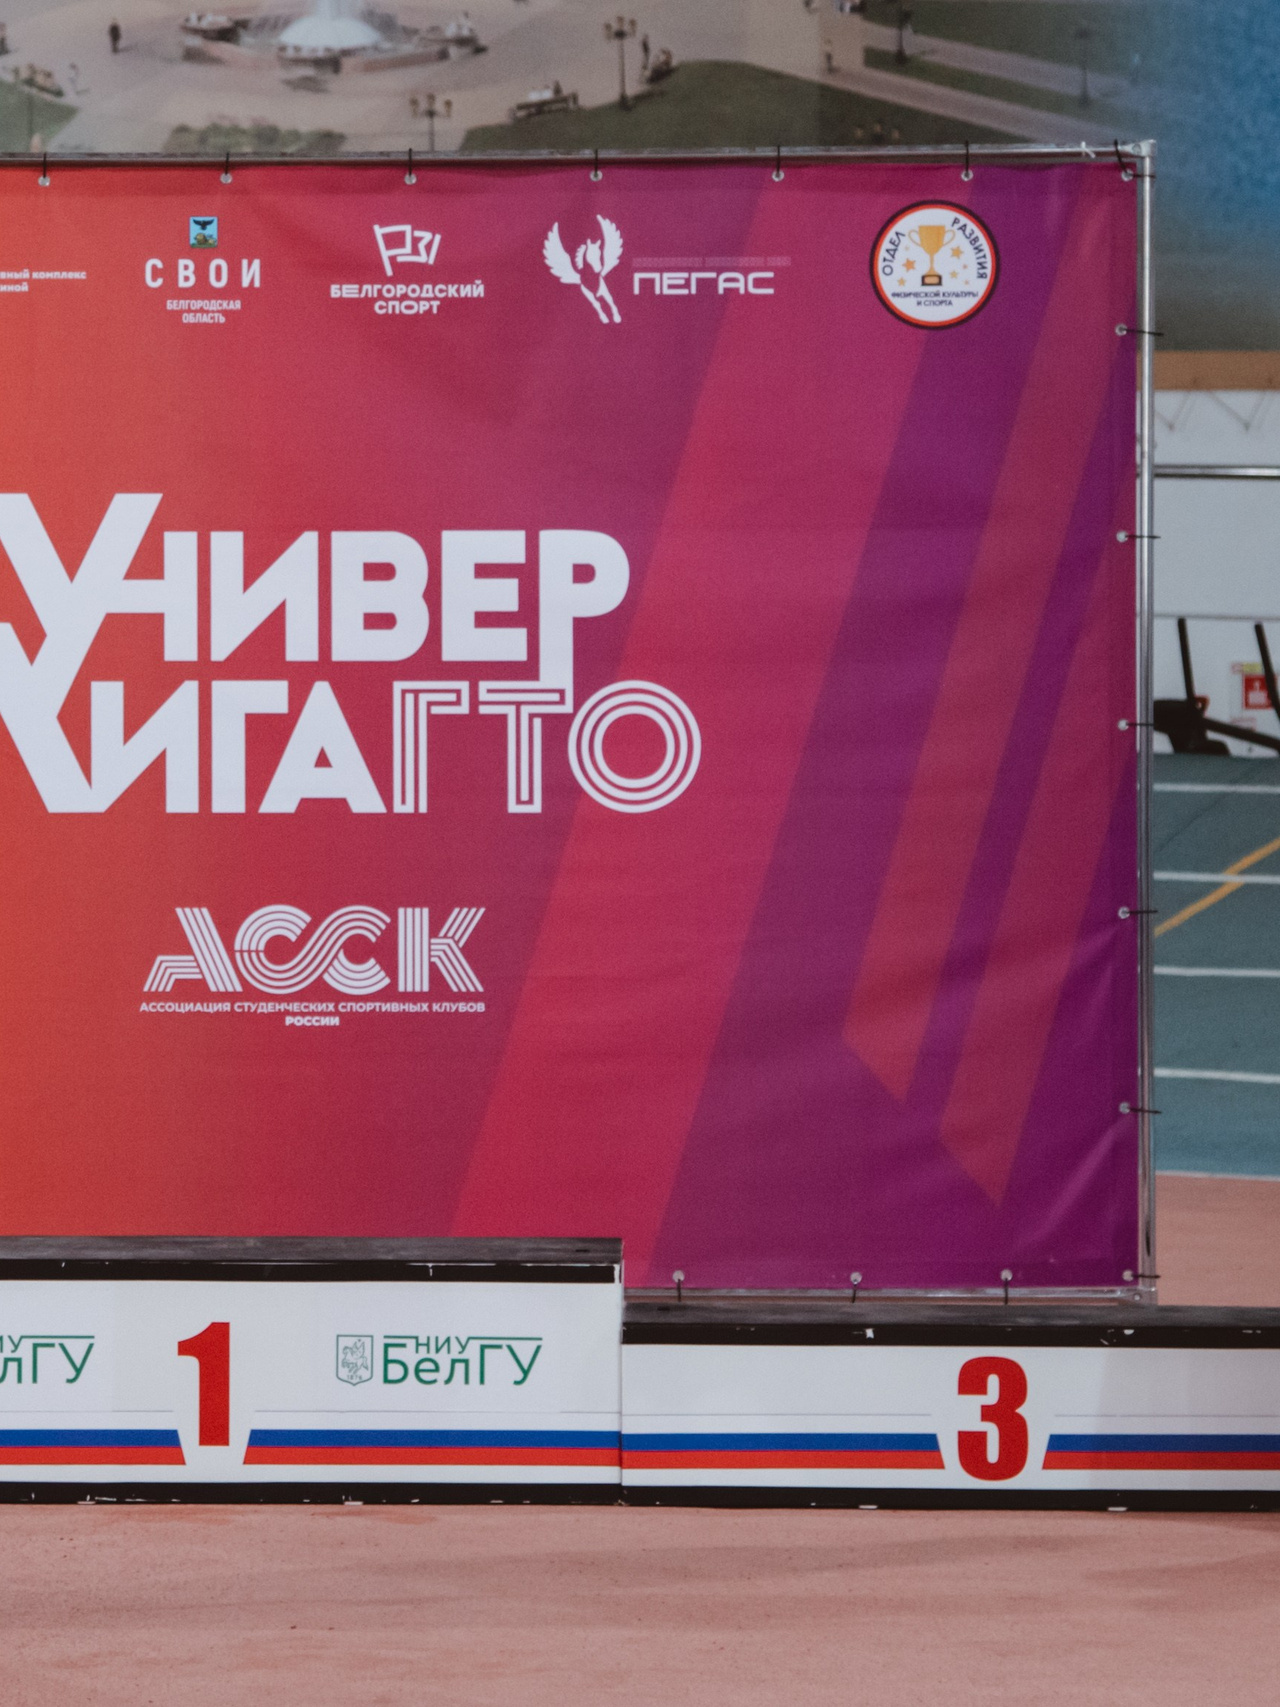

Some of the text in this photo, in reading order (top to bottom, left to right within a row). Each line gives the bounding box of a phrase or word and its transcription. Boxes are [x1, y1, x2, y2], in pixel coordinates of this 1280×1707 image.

[882, 231, 906, 276] ОТДЕЛ
[951, 216, 988, 279] РАЗВИТИЯ
[32, 271, 87, 279] комплекс
[633, 271, 775, 295] ПЕГАС
[330, 279, 485, 298] БЕЛГОРОДСКИЙ
[891, 290, 941, 298] ФИЗИЧЕСКОЙ
[166, 299, 241, 311] БЕЛГОРОДСКАЯ
[374, 300, 440, 315] СПОРТ
[182, 312, 226, 323] ОБЛАСТЬ
[143, 905, 486, 995] АССК
[139, 1002, 486, 1014] АССОЦИАЦИЯ СТУДЕНЧЕСКИХ СПОРТИВНЫХ КЛУБОВ
[285, 1016, 340, 1027] РОССИИ
[415, 1336, 470, 1354] НИУ
[383, 1343, 542, 1385] БелГУ
[177, 1321, 231, 1447] 1
[957, 1356, 1029, 1482] 3
